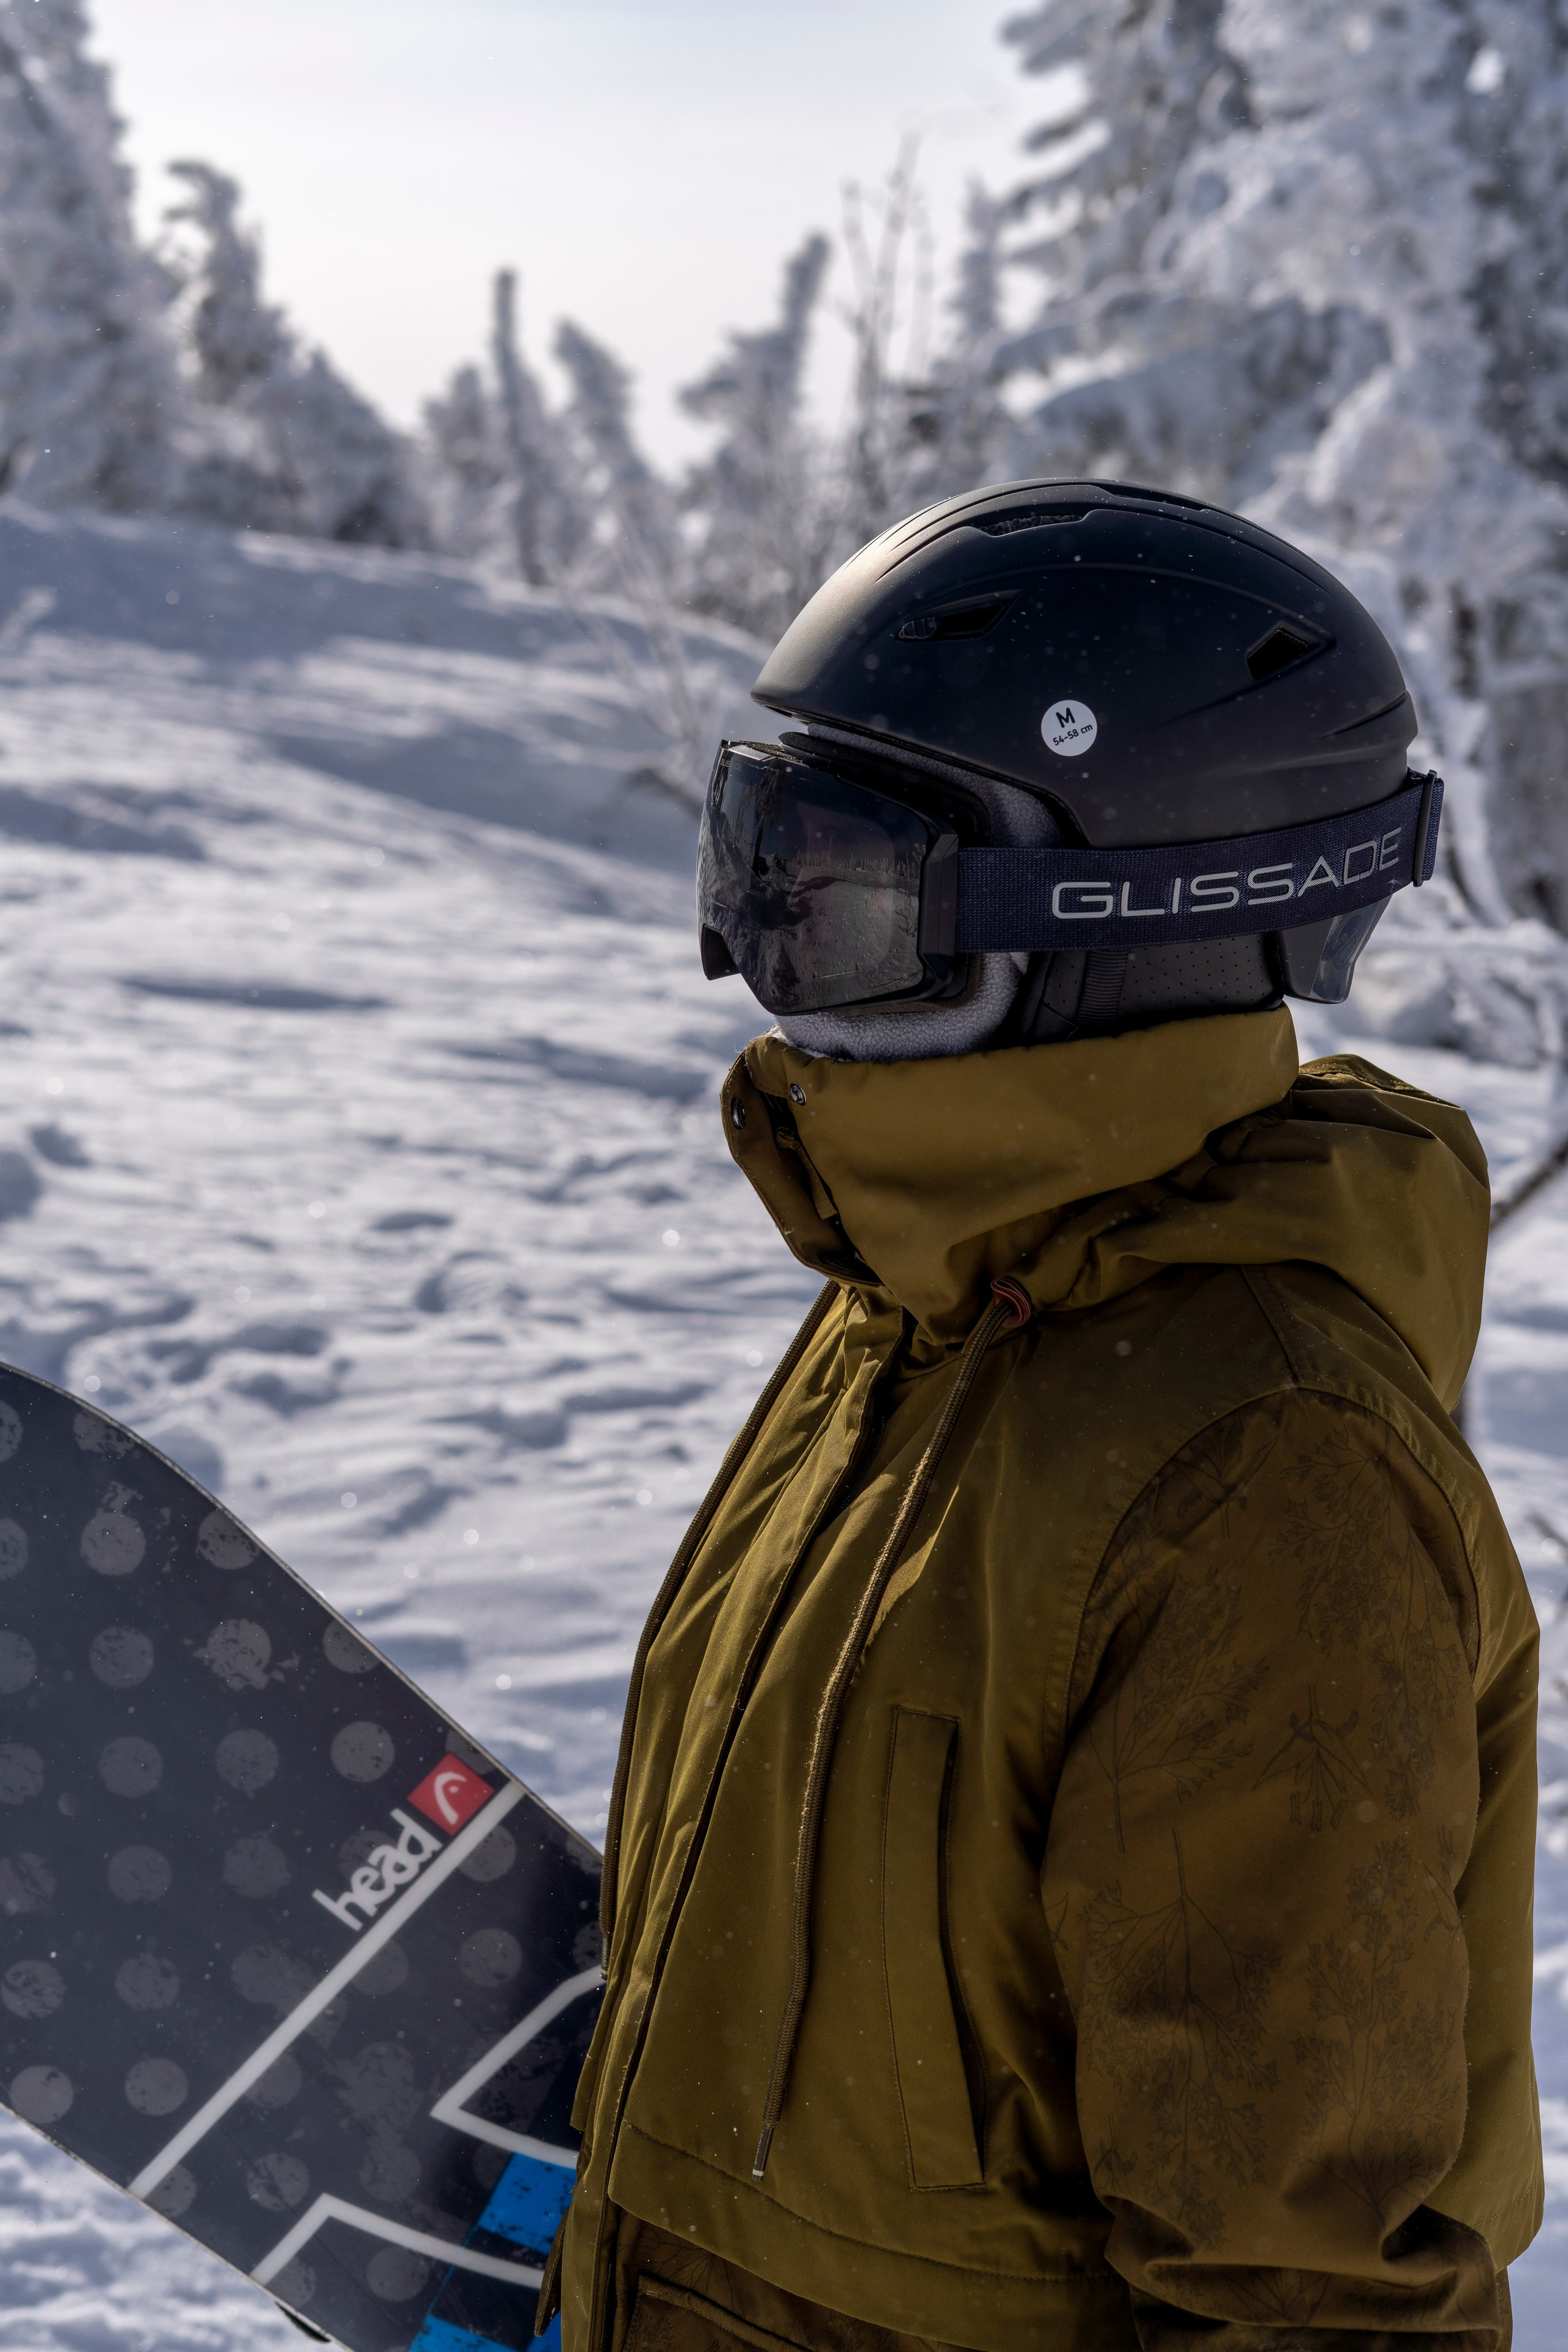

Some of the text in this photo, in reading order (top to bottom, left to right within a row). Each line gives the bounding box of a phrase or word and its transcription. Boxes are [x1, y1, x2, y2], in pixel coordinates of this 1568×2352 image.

[1053, 725, 1093, 745] 54-58 cm
[1055, 707, 1076, 728] M
[1052, 827, 1402, 919] GLISSADE
[312, 1807, 443, 1931] head
